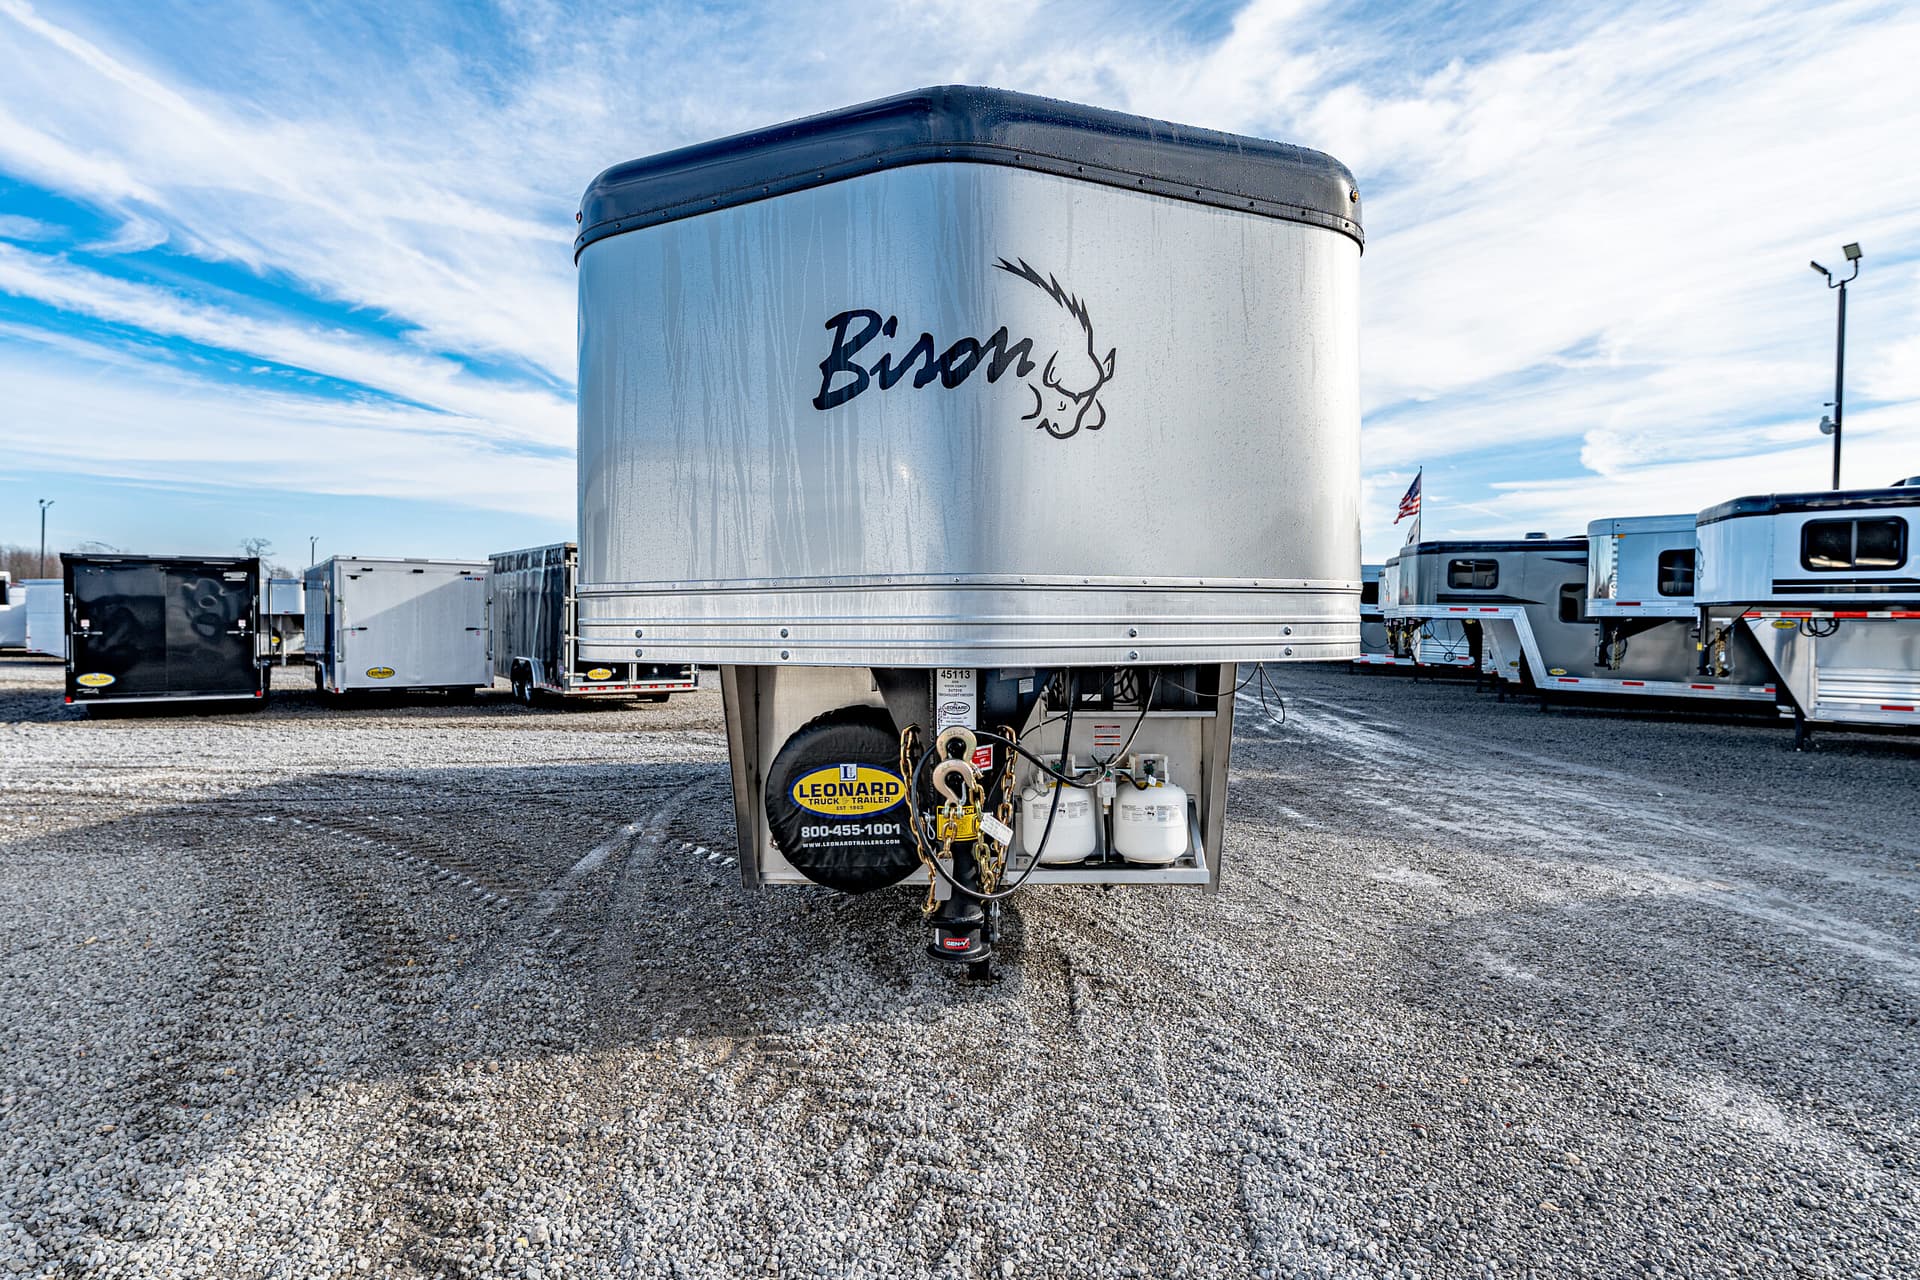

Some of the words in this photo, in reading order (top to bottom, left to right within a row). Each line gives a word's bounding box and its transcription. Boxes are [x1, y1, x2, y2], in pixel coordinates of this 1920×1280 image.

[812, 309, 1036, 411] Bison
[940, 670, 971, 679] 45113
[799, 782, 899, 798] LEONARD
[851, 796, 890, 804] TRAILER
[801, 823, 901, 838] 800-455-1001
[802, 839, 900, 848] WWW.LEONARDTRAILERS.COM
